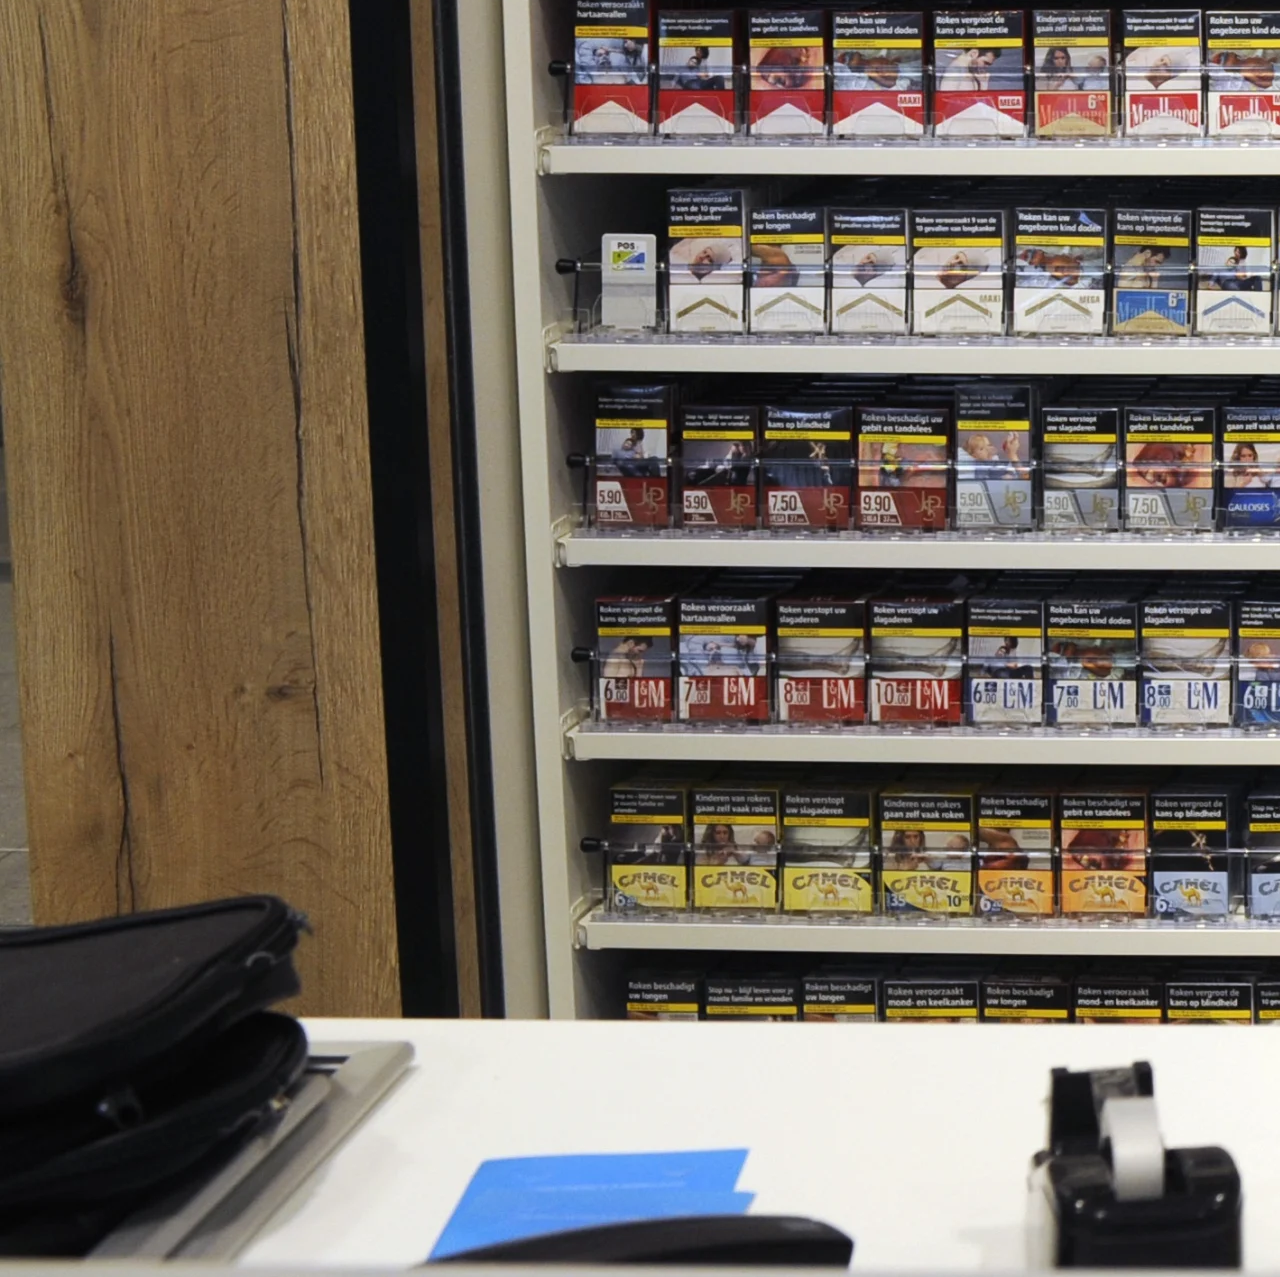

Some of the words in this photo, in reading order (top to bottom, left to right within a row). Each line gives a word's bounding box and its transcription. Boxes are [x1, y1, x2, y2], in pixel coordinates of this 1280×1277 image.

[899, 96, 922, 106] MAXI
[617, 241, 636, 251] POS
[771, 492, 799, 512] 7.50
[863, 493, 891, 513] 9.90
[1228, 501, 1271, 513] GAULOISES
[723, 677, 755, 706] L&M
[701, 870, 771, 890] CAMEL
